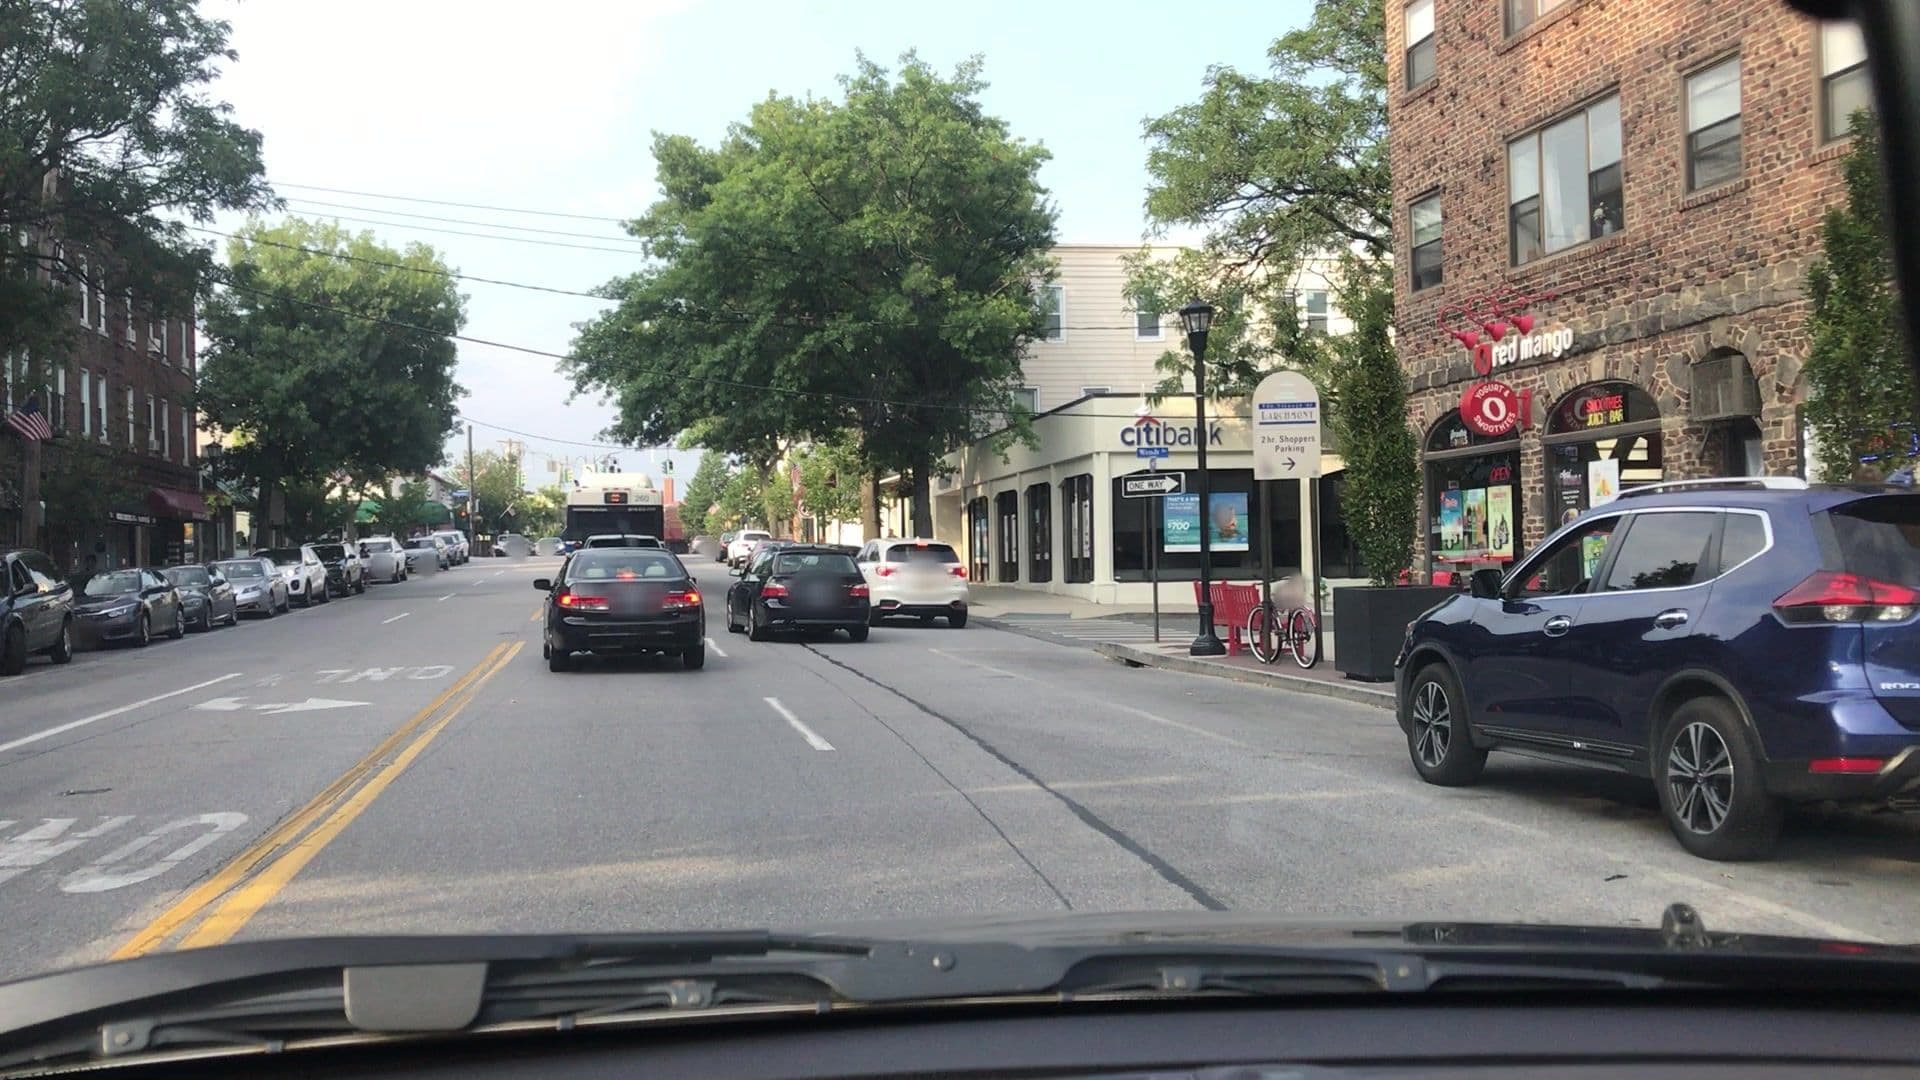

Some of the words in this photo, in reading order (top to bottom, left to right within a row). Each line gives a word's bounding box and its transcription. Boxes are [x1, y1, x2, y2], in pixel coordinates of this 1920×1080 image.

[1492, 335, 1518, 367] red
[1520, 328, 1574, 358] mango
[1475, 384, 1504, 399] YOGURT
[1474, 412, 1516, 433] SMOOTHIES
[1279, 434, 1315, 444] Shoppers
[1275, 445, 1305, 453] Parking
[1129, 481, 1144, 490] ONE
[1147, 480, 1165, 489] WAY
[1167, 521, 1190, 530] $700
